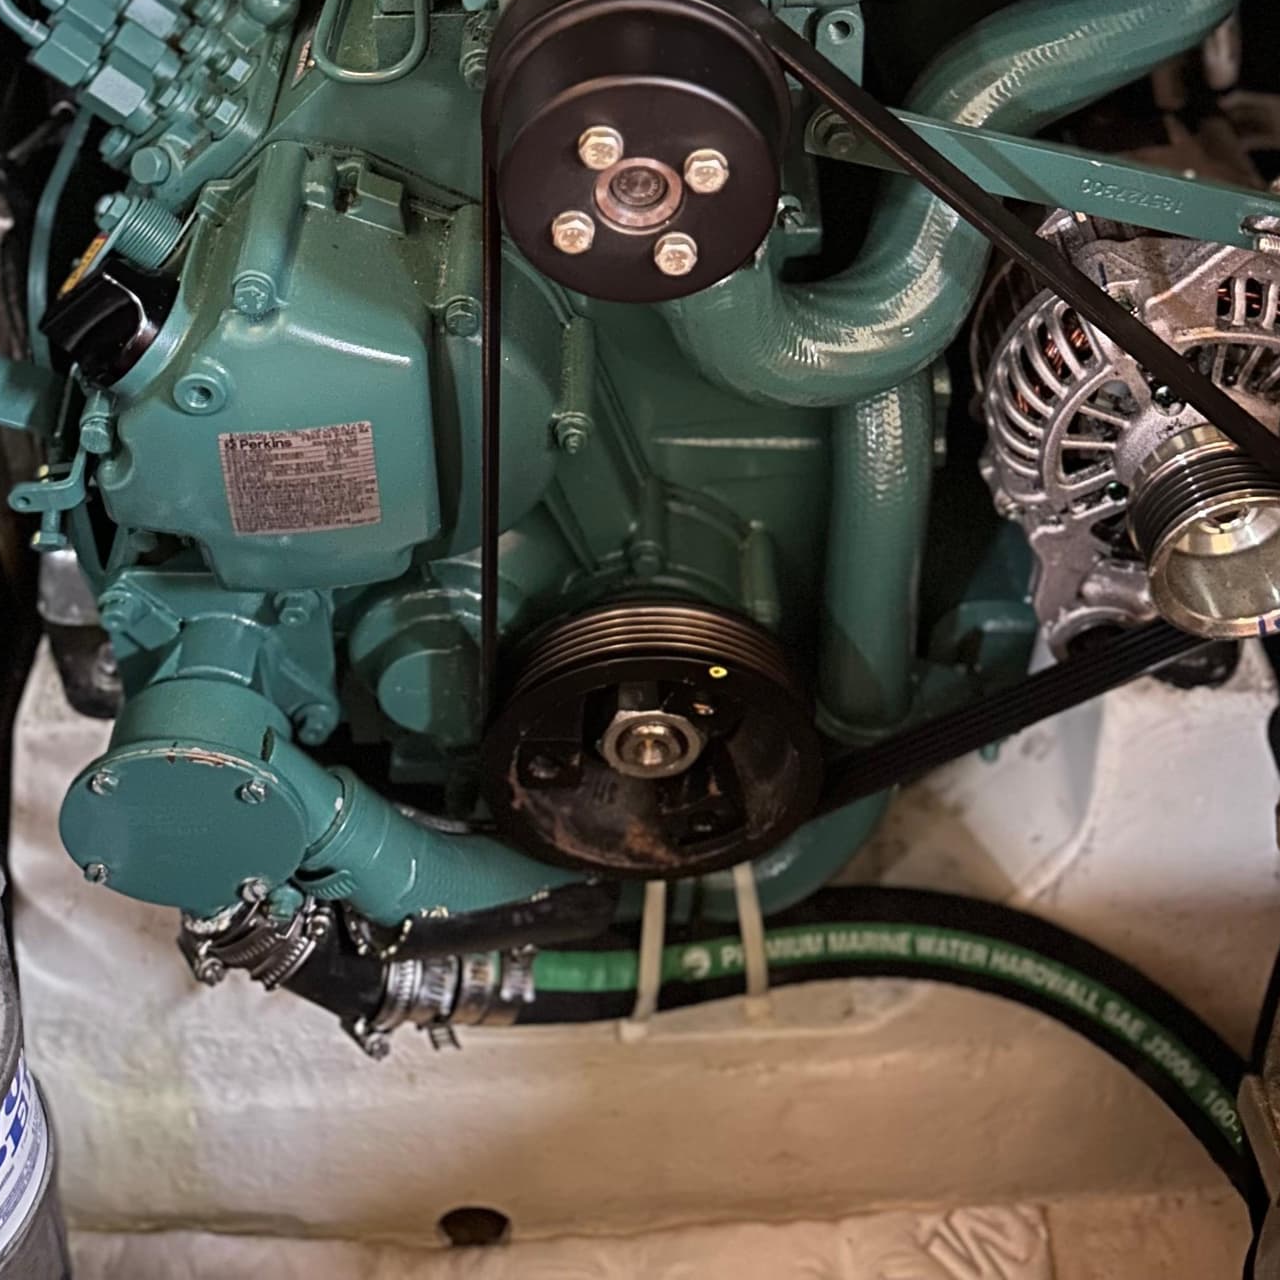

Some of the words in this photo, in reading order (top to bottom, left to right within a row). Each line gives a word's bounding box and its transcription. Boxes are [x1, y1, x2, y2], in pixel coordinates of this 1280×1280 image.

[239, 436, 293, 450] Perkins
[722, 931, 823, 968] PMIUM
[827, 930, 912, 955] MARINE
[914, 933, 988, 968] WATER
[987, 948, 1101, 1014] HARDWALL
[1101, 1000, 1148, 1041] SAE
